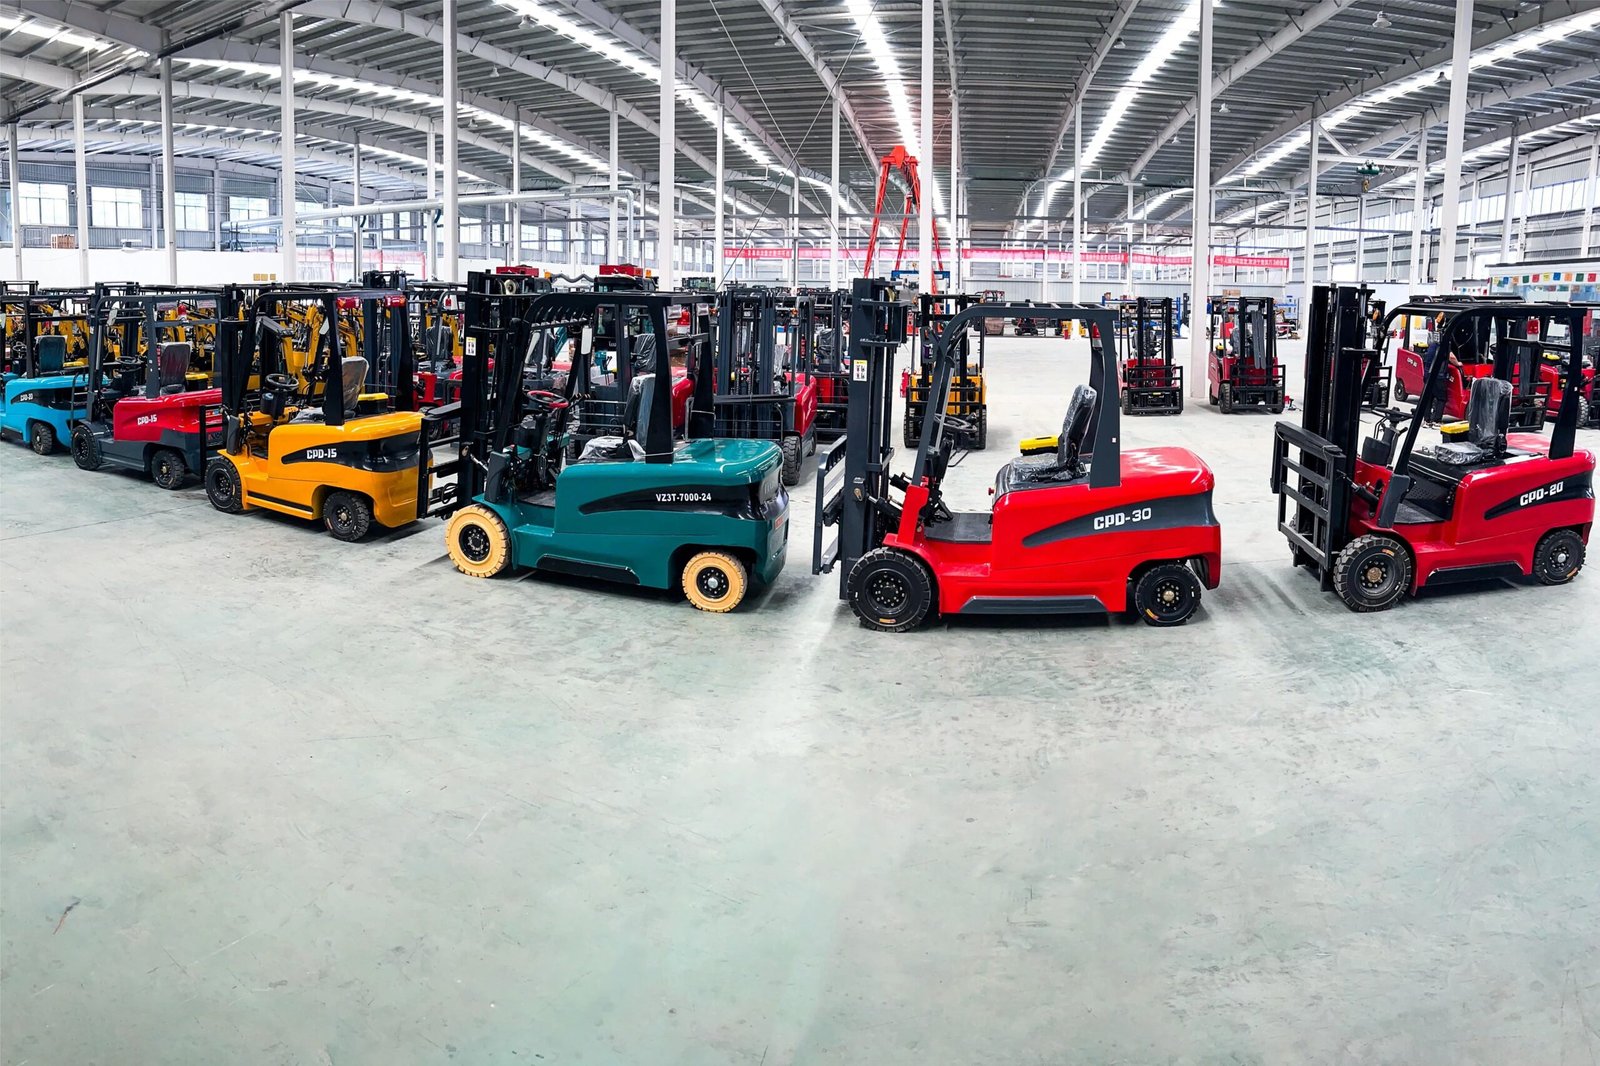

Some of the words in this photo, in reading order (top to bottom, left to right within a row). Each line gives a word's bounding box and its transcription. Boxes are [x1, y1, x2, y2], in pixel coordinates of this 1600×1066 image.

[137, 414, 158, 426] CPD-15
[306, 448, 338, 460] CPD-15
[655, 492, 712, 502] VZ3T-7000-24
[1520, 481, 1564, 506] CPD-20
[1093, 507, 1152, 530] CPD-30
